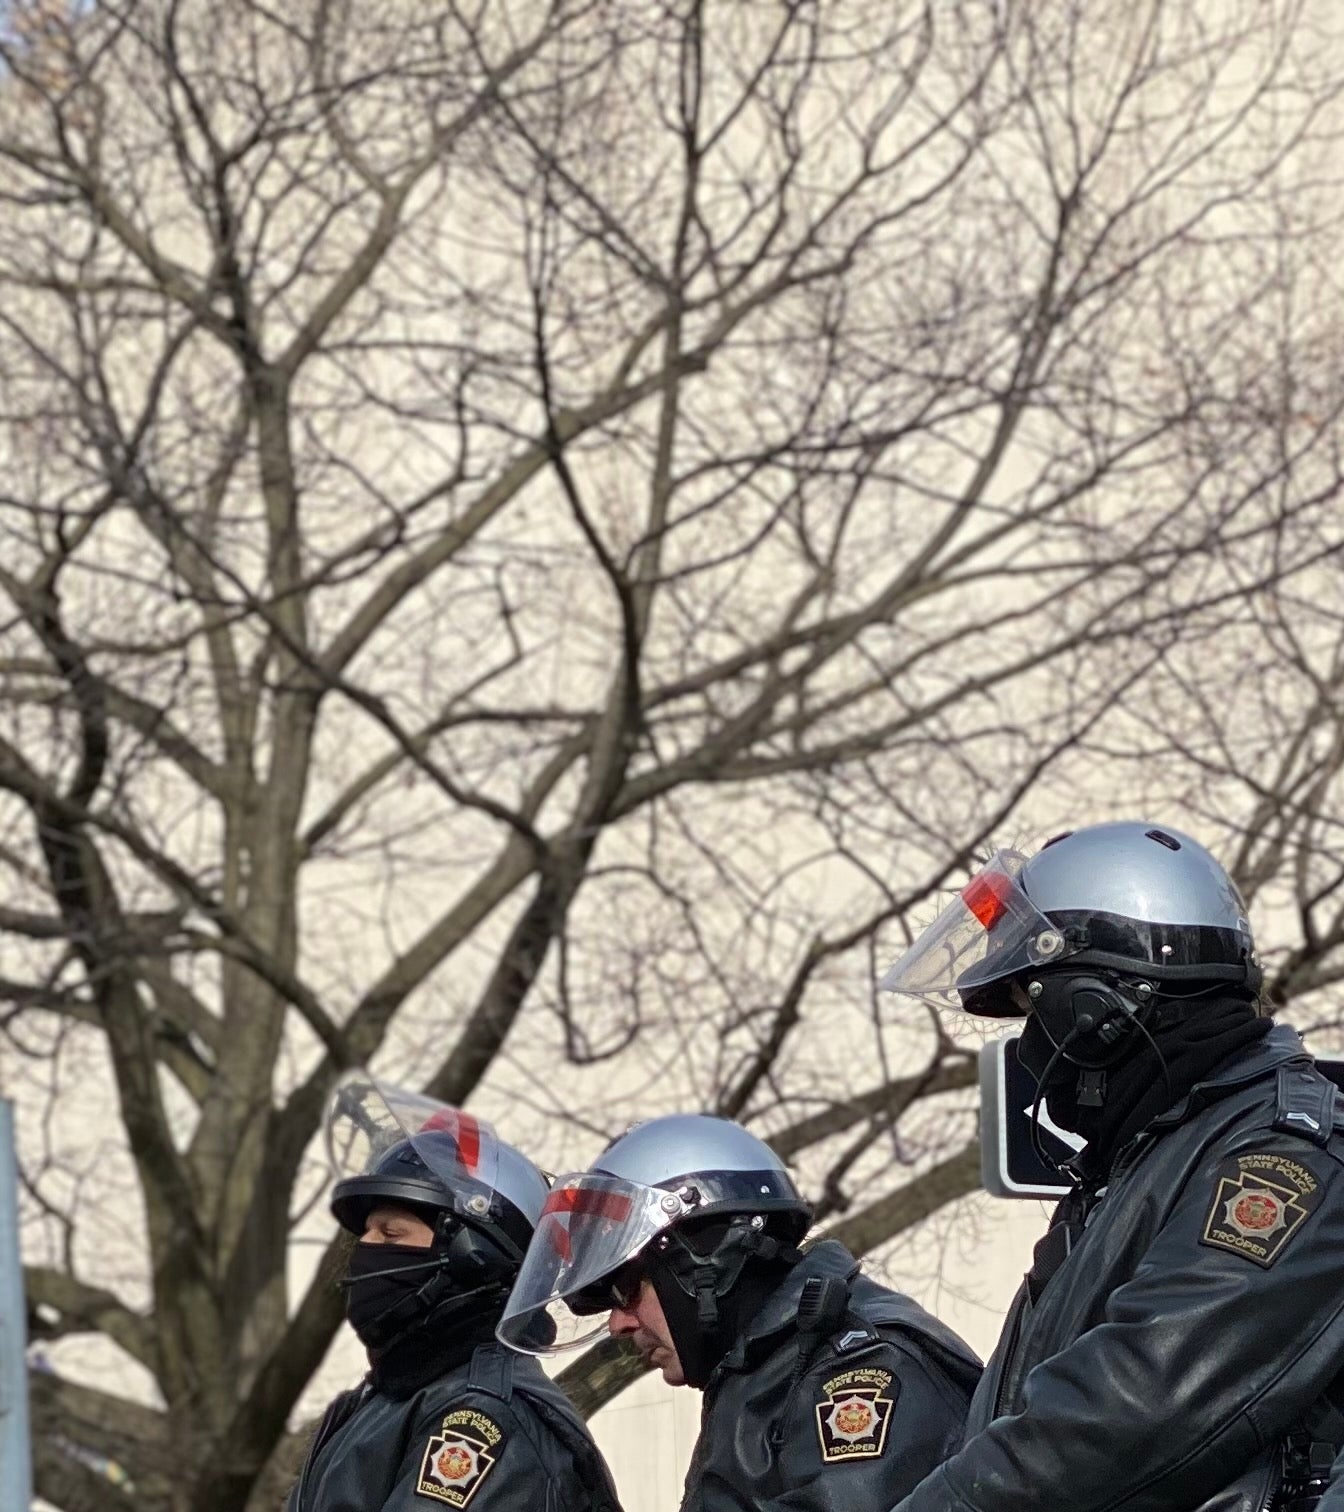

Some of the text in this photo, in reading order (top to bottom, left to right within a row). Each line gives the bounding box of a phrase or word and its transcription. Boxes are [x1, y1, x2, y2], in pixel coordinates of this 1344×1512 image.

[1237, 1154, 1317, 1192] PENNSYLVANIA
[1239, 1160, 1311, 1195] STATE POLICE
[1212, 1229, 1267, 1257] TROOPER
[825, 1375, 889, 1395] STATE POLICE
[442, 1410, 502, 1443] PENNSYLVANIA
[442, 1417, 497, 1446] STATE POLICE
[829, 1443, 876, 1455] TROOPER
[421, 1481, 465, 1503] TROOPER
